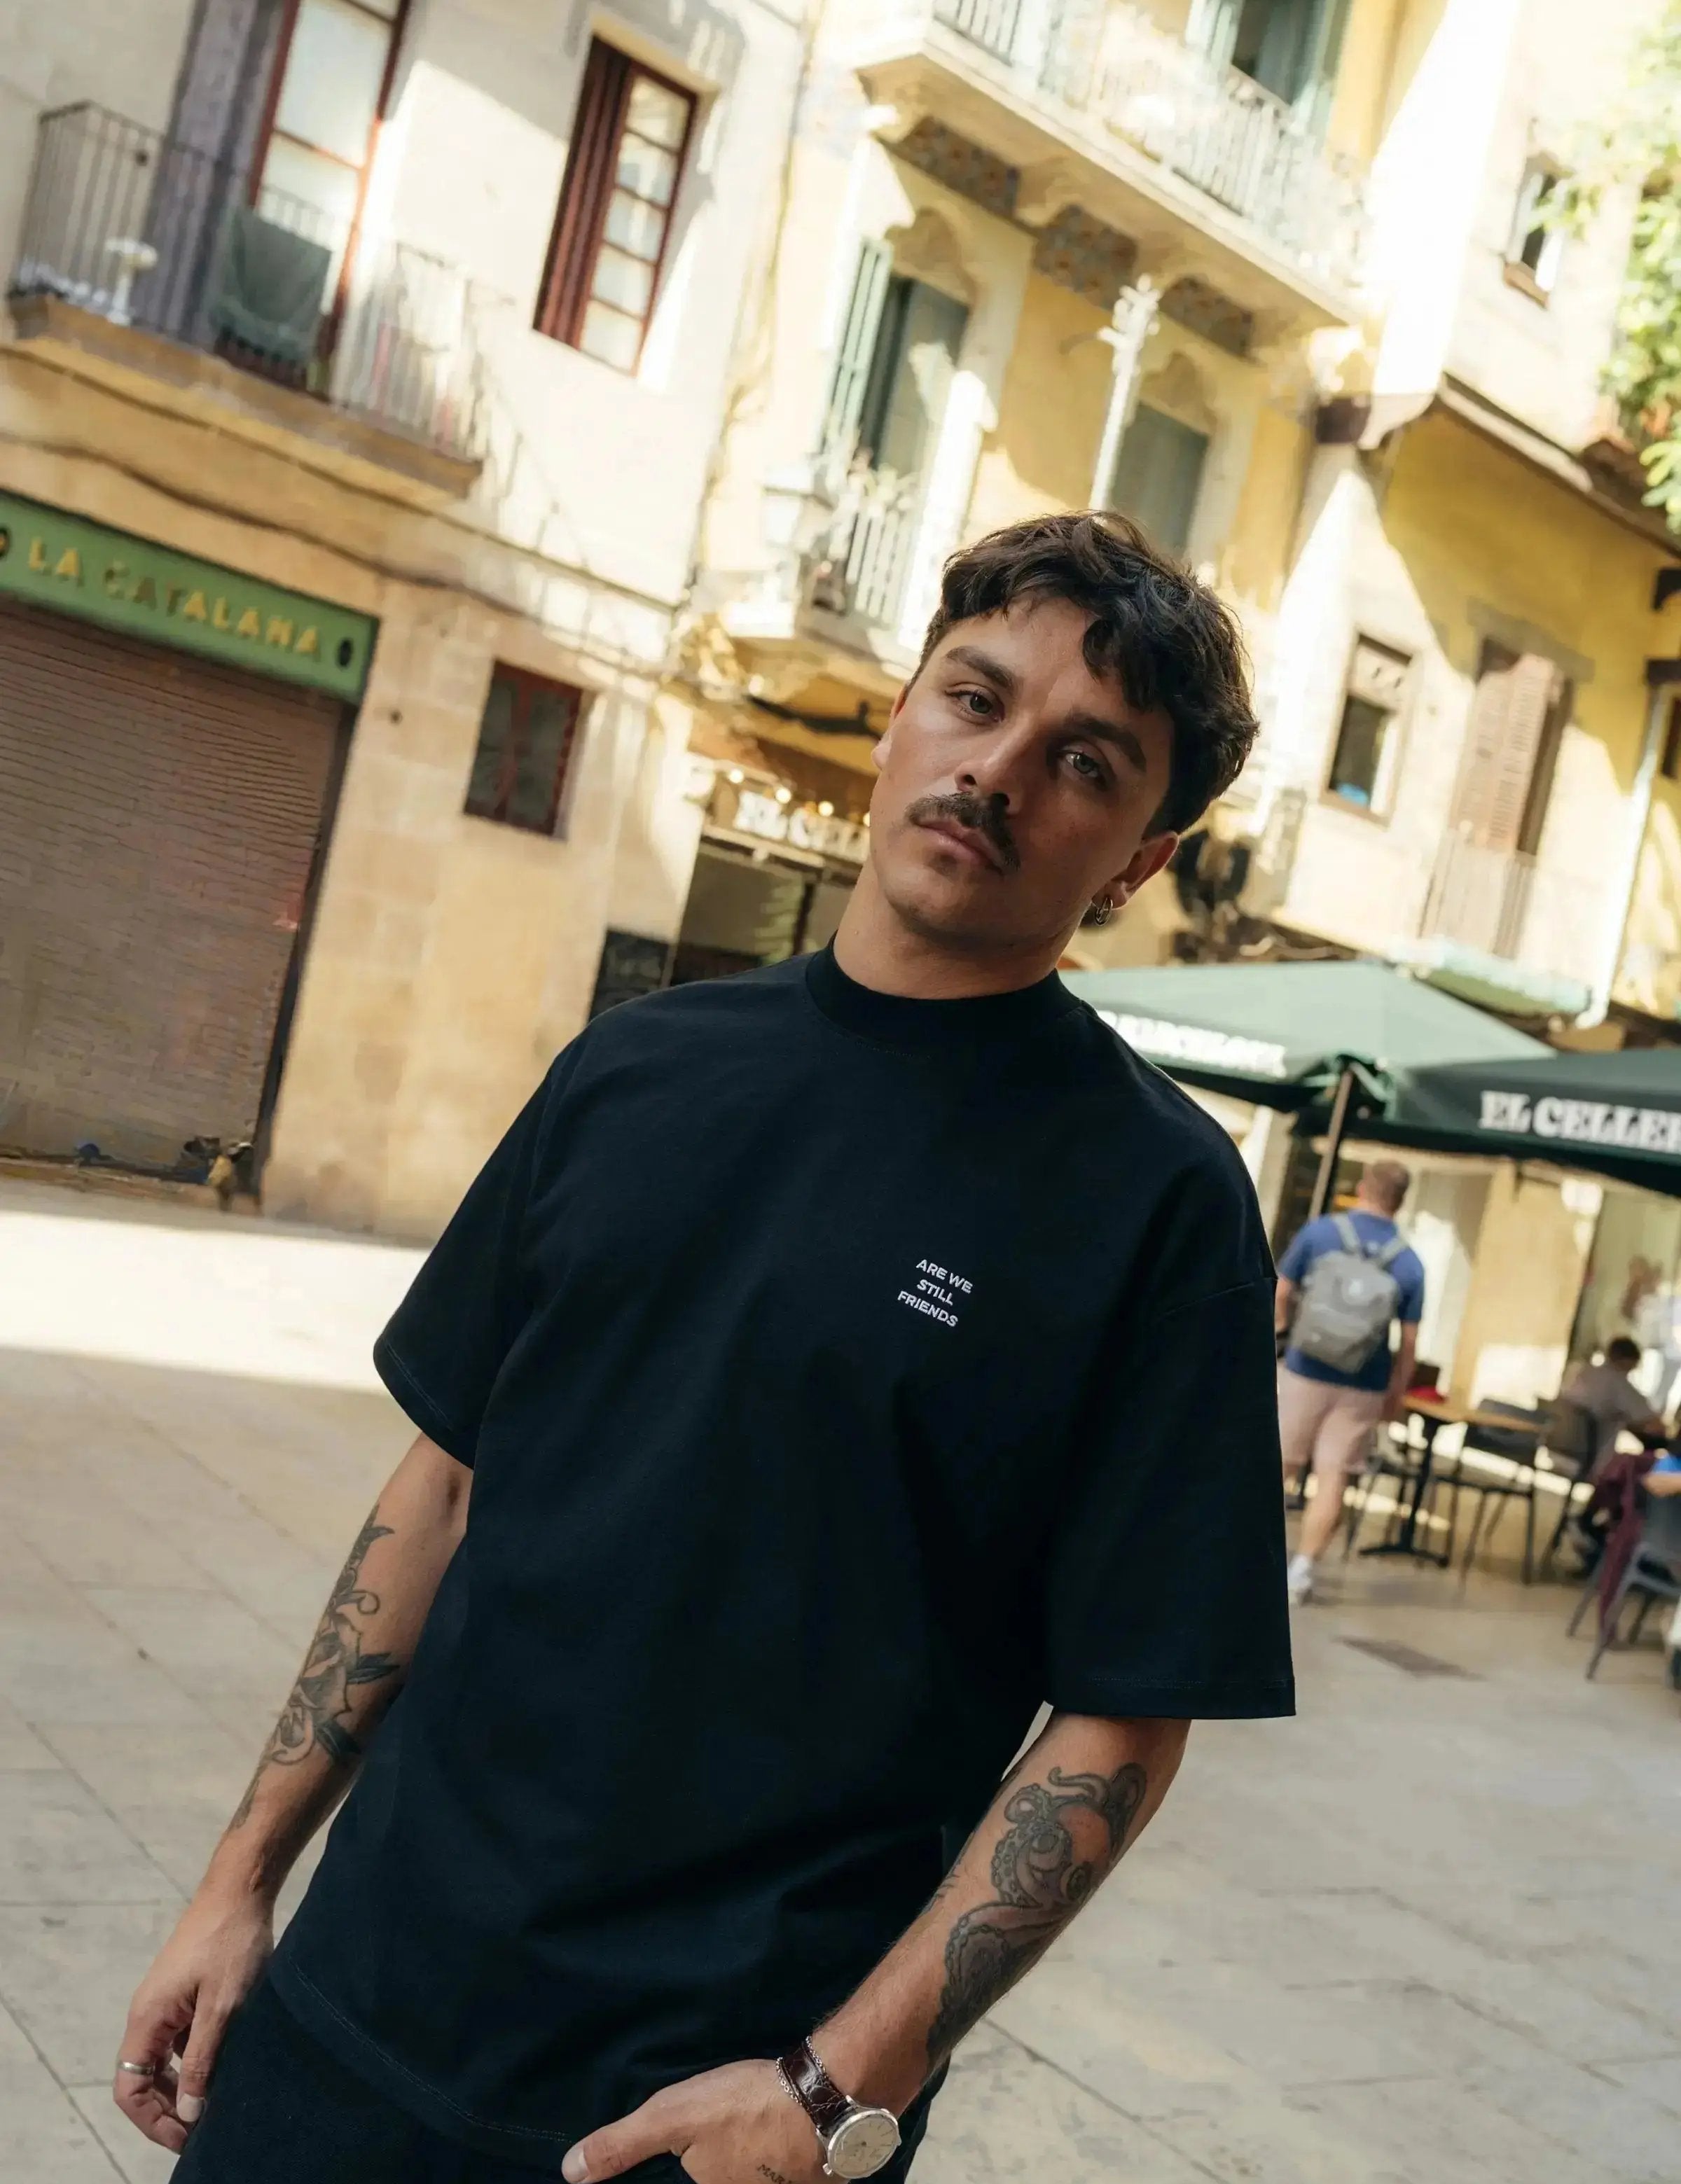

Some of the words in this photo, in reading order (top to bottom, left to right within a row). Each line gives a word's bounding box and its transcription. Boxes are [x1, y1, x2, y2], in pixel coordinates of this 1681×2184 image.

[28, 536, 83, 585] LA
[1479, 1090, 1531, 1134] EL
[915, 1259, 948, 1281] ARE
[948, 1272, 974, 1294] WE
[916, 1279, 953, 1306] STILL
[897, 1290, 958, 1327] FRIENDS
